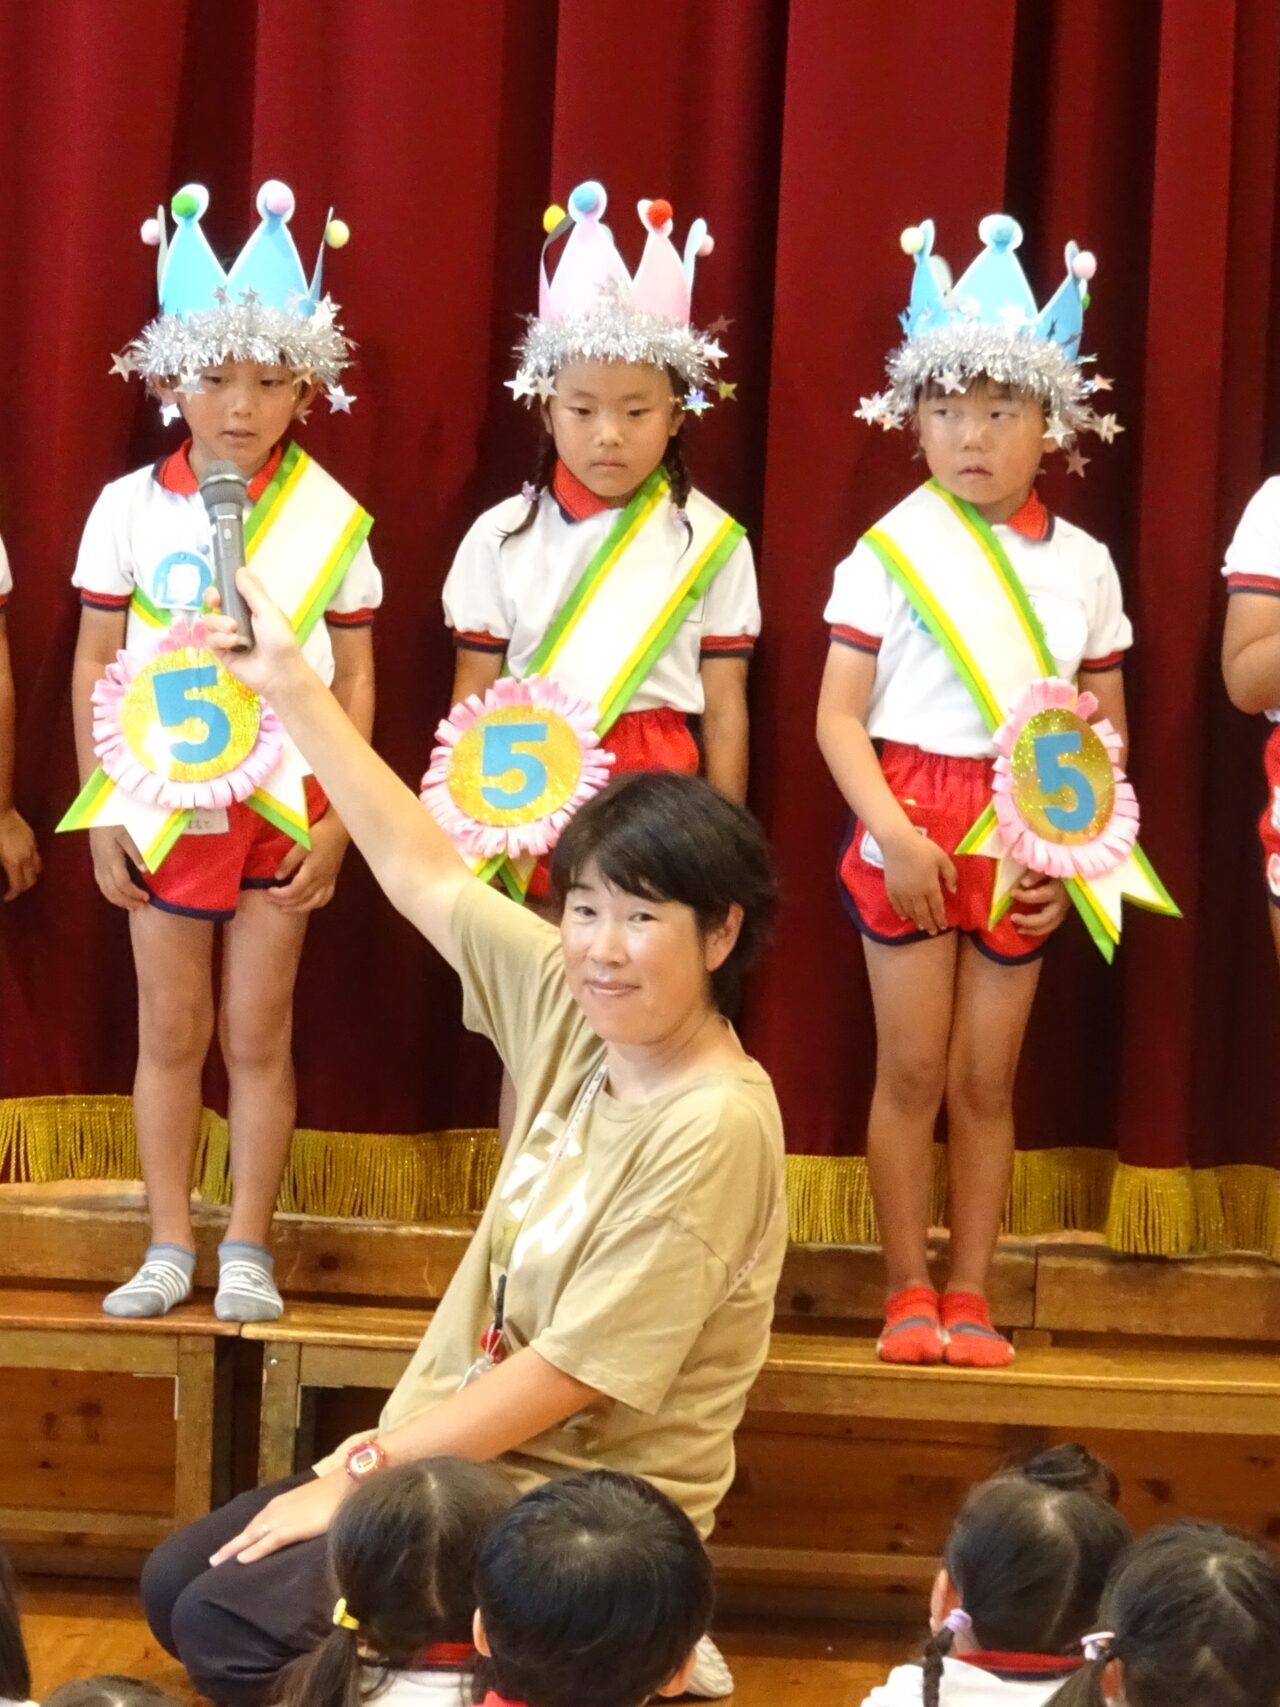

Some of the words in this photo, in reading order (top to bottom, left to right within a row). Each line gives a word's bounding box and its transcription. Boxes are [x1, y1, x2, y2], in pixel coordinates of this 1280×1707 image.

[153, 666, 231, 763] 5
[481, 724, 547, 809] 5
[1033, 730, 1095, 831] 5
